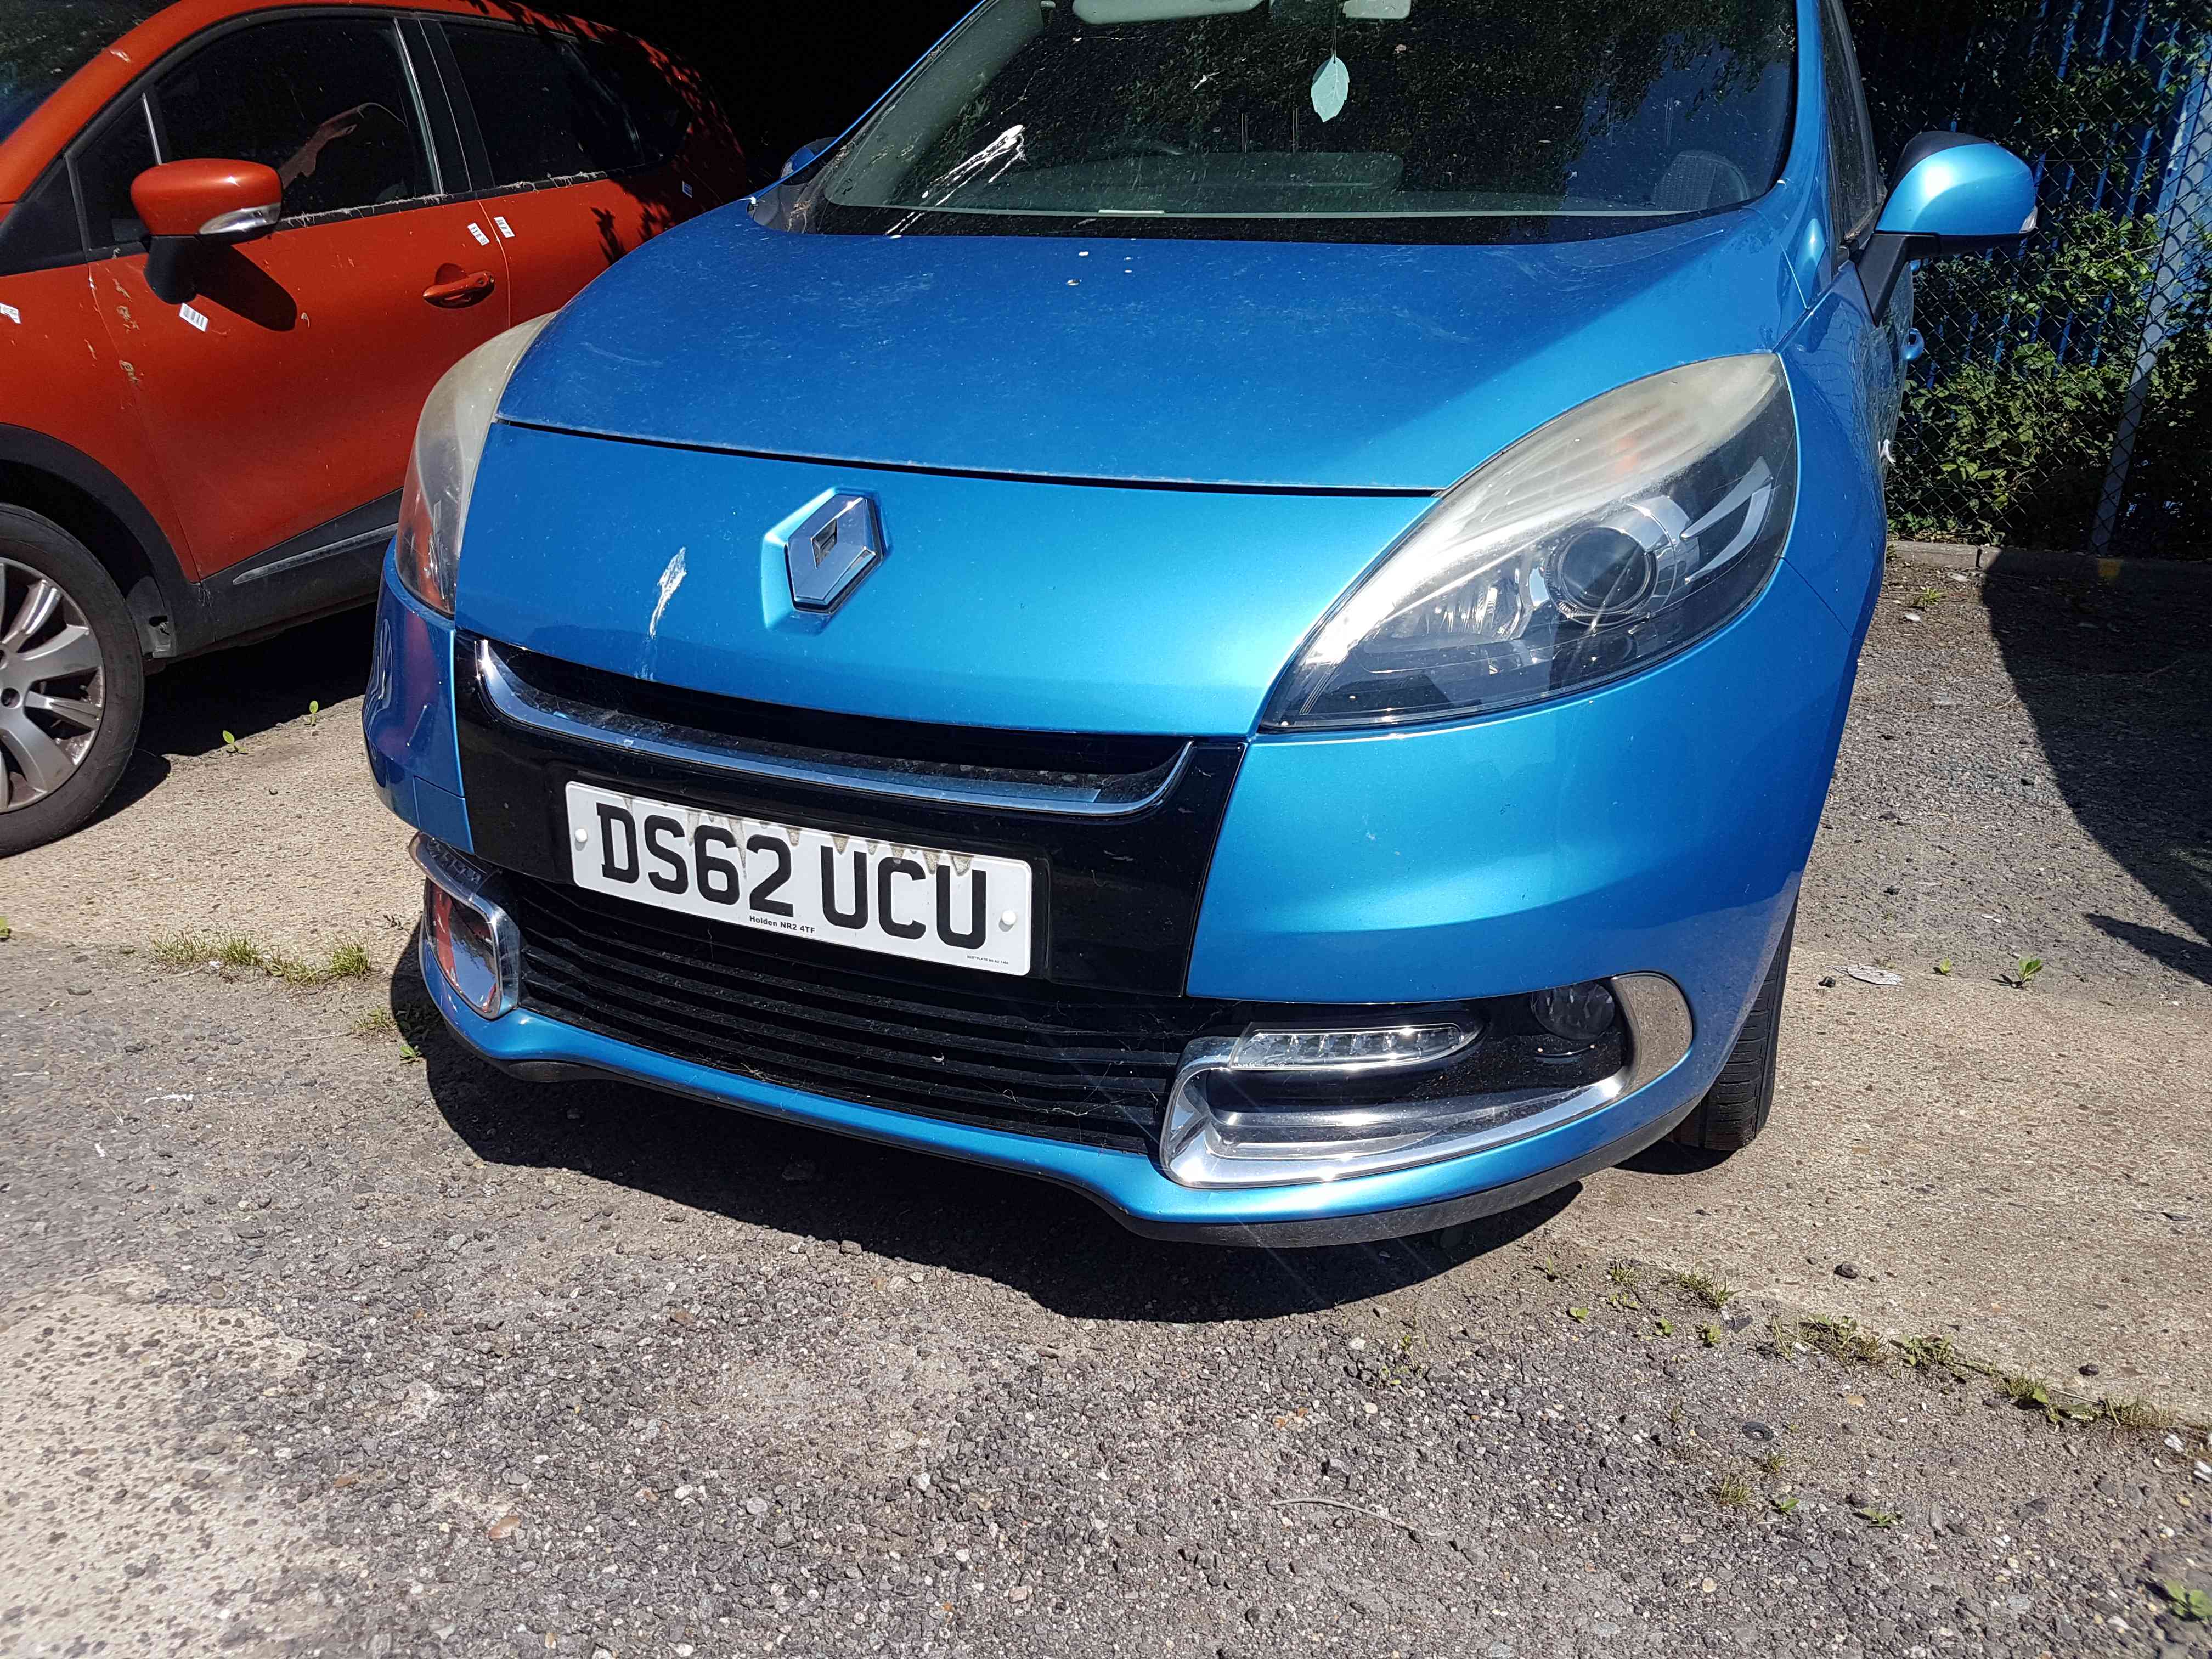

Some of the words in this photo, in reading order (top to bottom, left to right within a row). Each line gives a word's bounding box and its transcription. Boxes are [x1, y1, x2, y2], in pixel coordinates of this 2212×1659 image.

[596, 802, 794, 918] DS62
[820, 845, 987, 950] UCU
[749, 915, 777, 927] Holden
[780, 921, 797, 930] NR2
